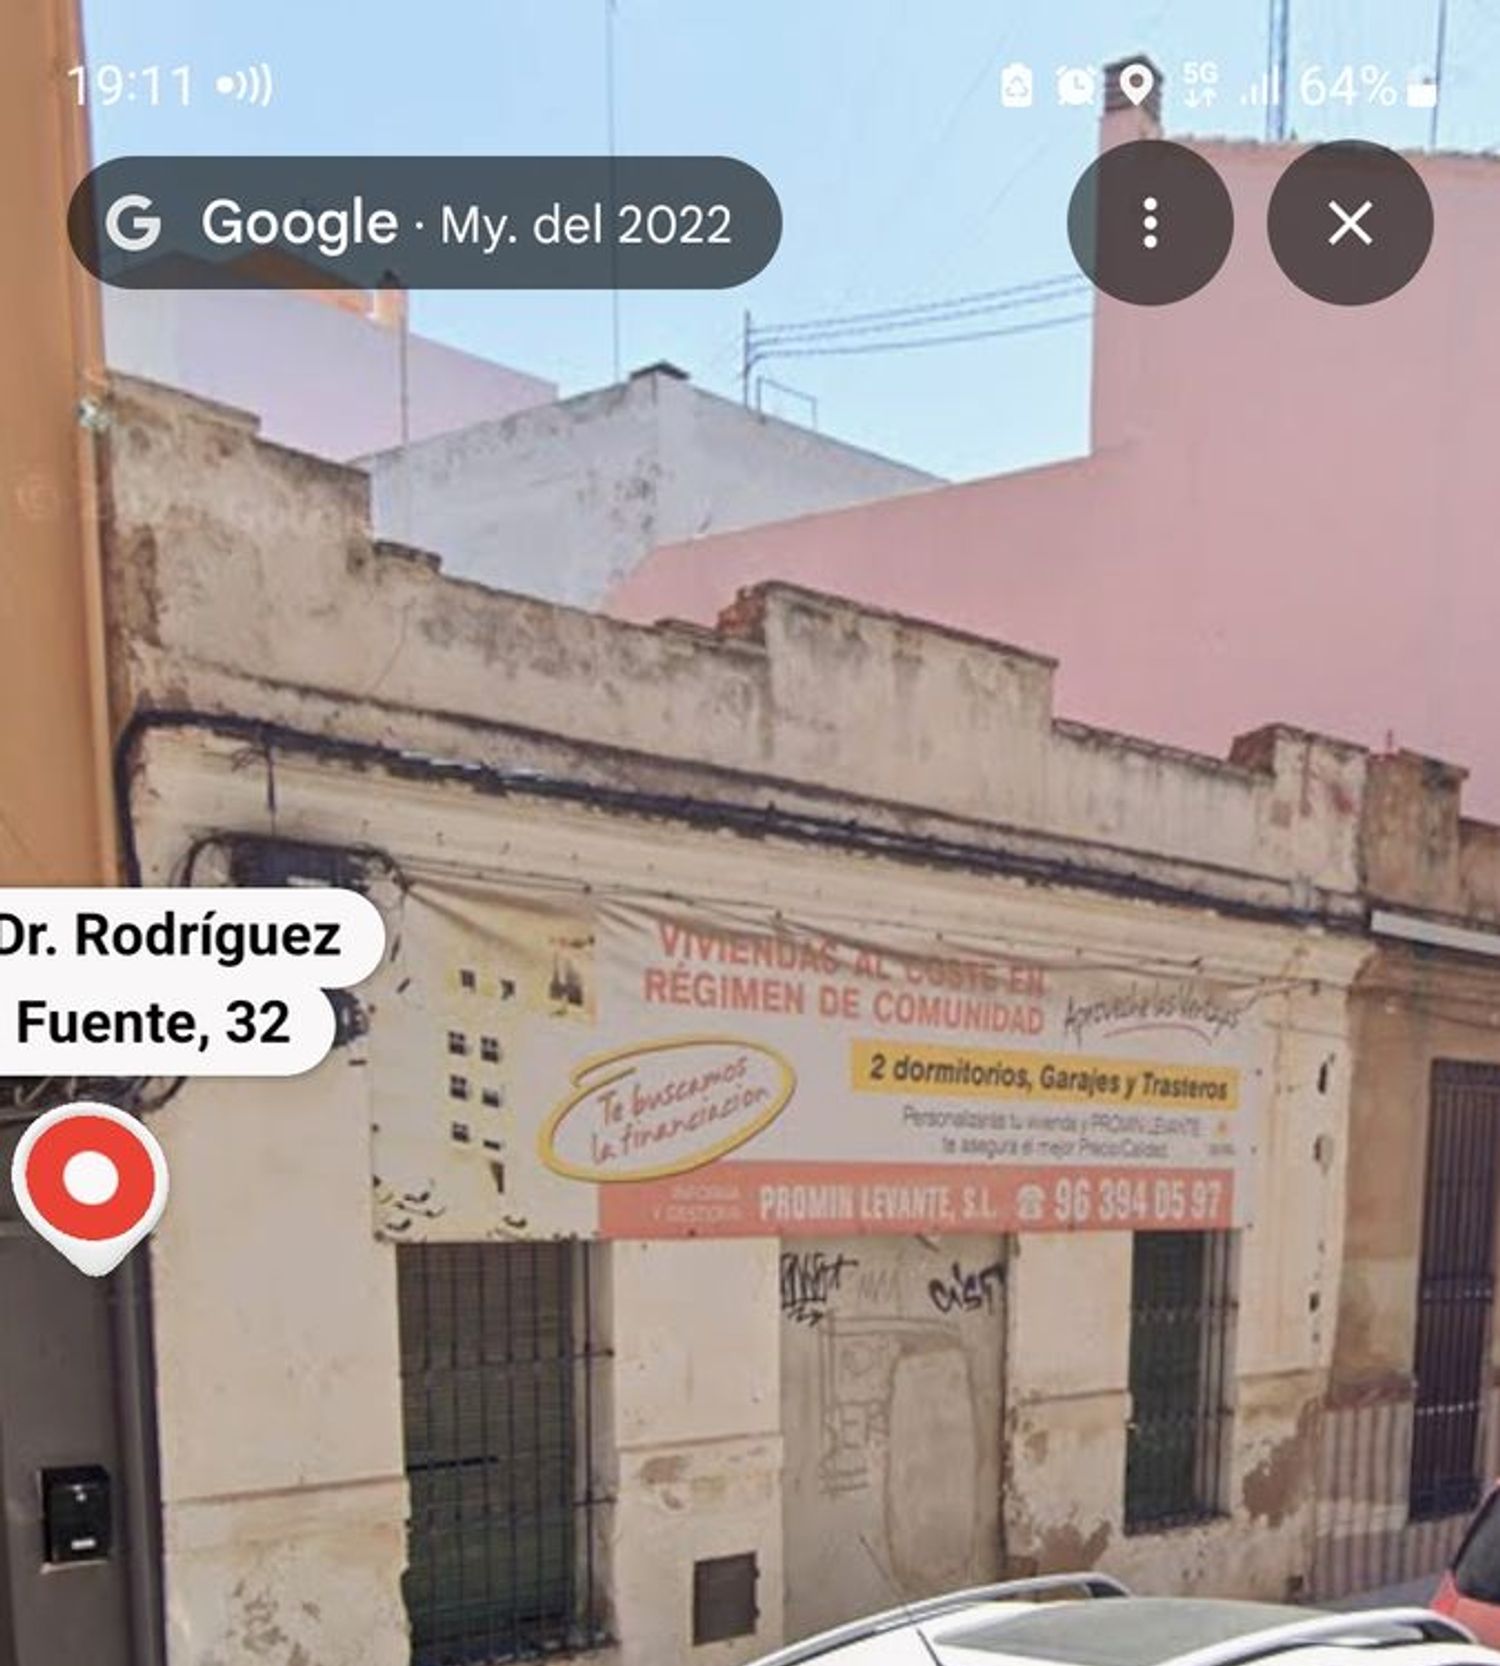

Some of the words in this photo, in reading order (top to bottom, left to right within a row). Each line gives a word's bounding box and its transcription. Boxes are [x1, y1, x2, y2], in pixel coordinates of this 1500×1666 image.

[658, 919, 840, 976] VIVIENDAS
[854, 950, 891, 980] AL
[906, 955, 1001, 993] COSTE
[1009, 966, 1047, 998] EN
[644, 961, 805, 1015] RÉGIMEN
[818, 985, 861, 1020] DE
[874, 989, 1045, 1036] COMUNIDAD
[598, 1089, 623, 1127] Te
[630, 1054, 748, 1118] buscamos
[869, 1054, 887, 1081] 2
[893, 1054, 1033, 1094] dormitorios,
[1039, 1065, 1121, 1096] Garajes
[1123, 1077, 1137, 1100] y
[1142, 1071, 1229, 1101] Trasteros
[590, 1132, 618, 1166] la
[759, 1183, 853, 1221] PROMIN
[963, 1187, 997, 1219] S.L.
[1054, 1178, 1091, 1223] 96
[1101, 1178, 1148, 1221] 394
[1154, 1178, 1185, 1221] 05
[1190, 1180, 1223, 1221] 97
